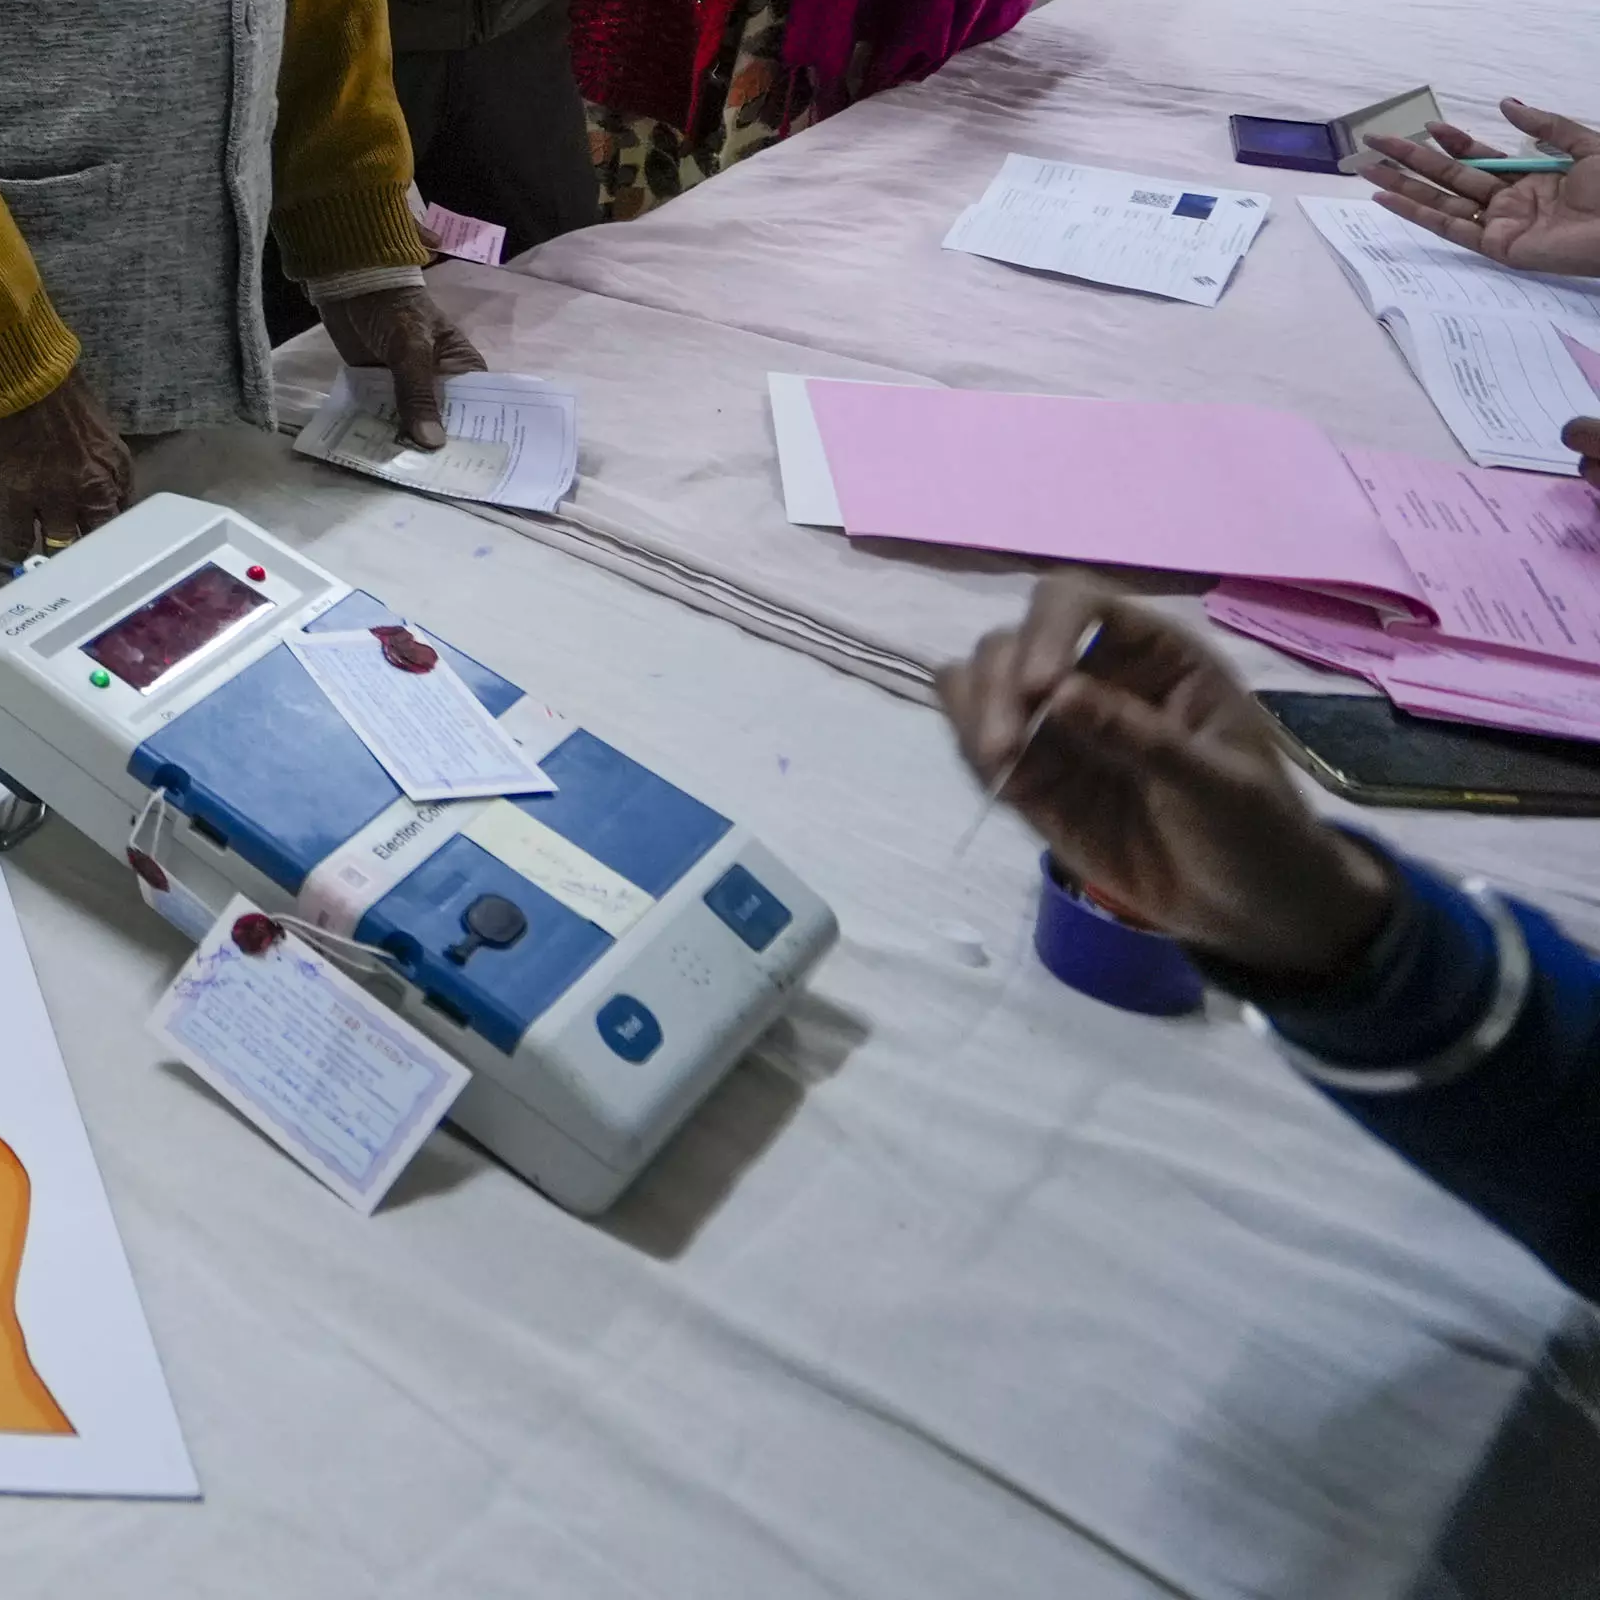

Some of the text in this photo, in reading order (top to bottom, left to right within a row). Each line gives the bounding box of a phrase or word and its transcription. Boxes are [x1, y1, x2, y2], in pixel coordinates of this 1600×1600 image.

[5, 610, 46, 637] Control
[46, 596, 72, 620] Unit
[372, 816, 425, 861] Election
